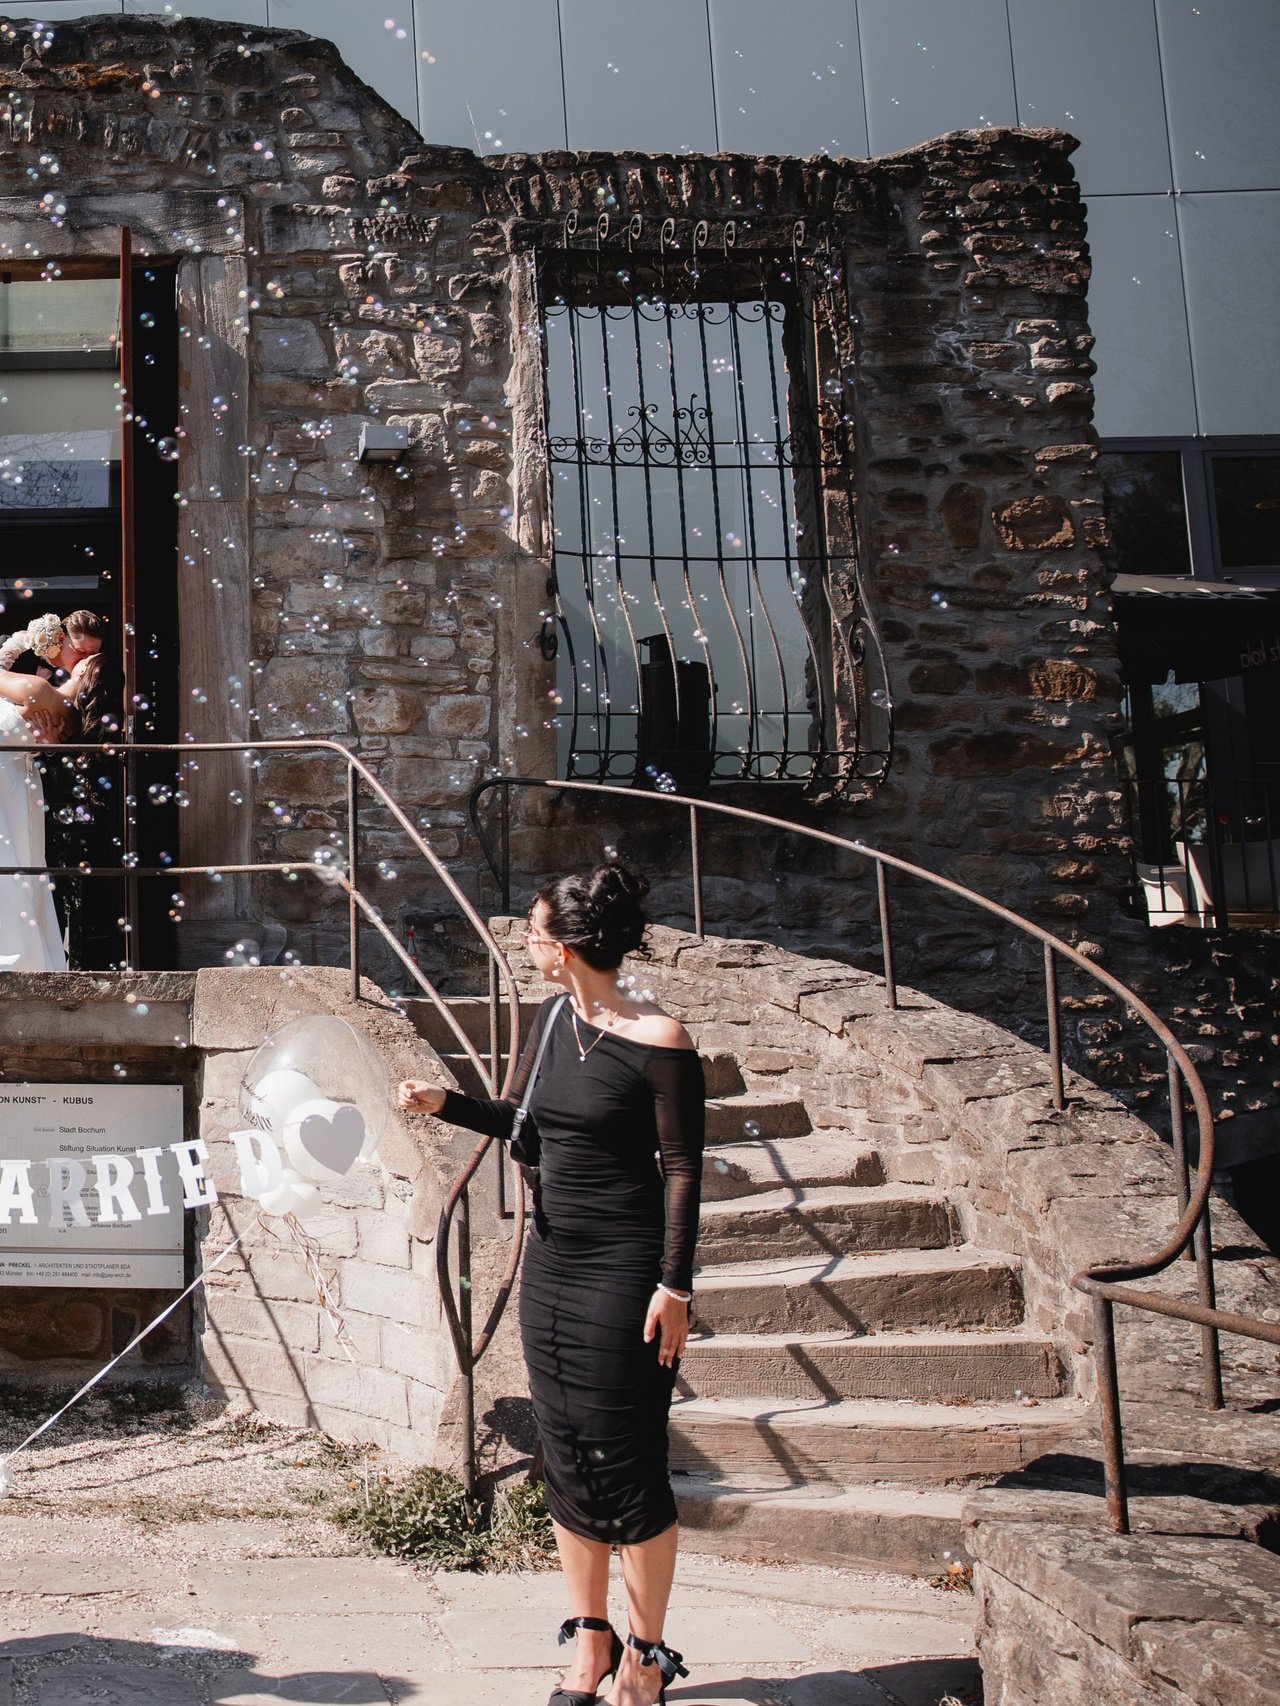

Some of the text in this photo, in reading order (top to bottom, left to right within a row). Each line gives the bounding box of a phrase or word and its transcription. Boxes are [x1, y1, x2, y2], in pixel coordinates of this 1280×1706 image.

[12, 1096, 46, 1104] KUNST"
[63, 1097, 94, 1105] KUBUS
[59, 1145, 85, 1153] Stiftung
